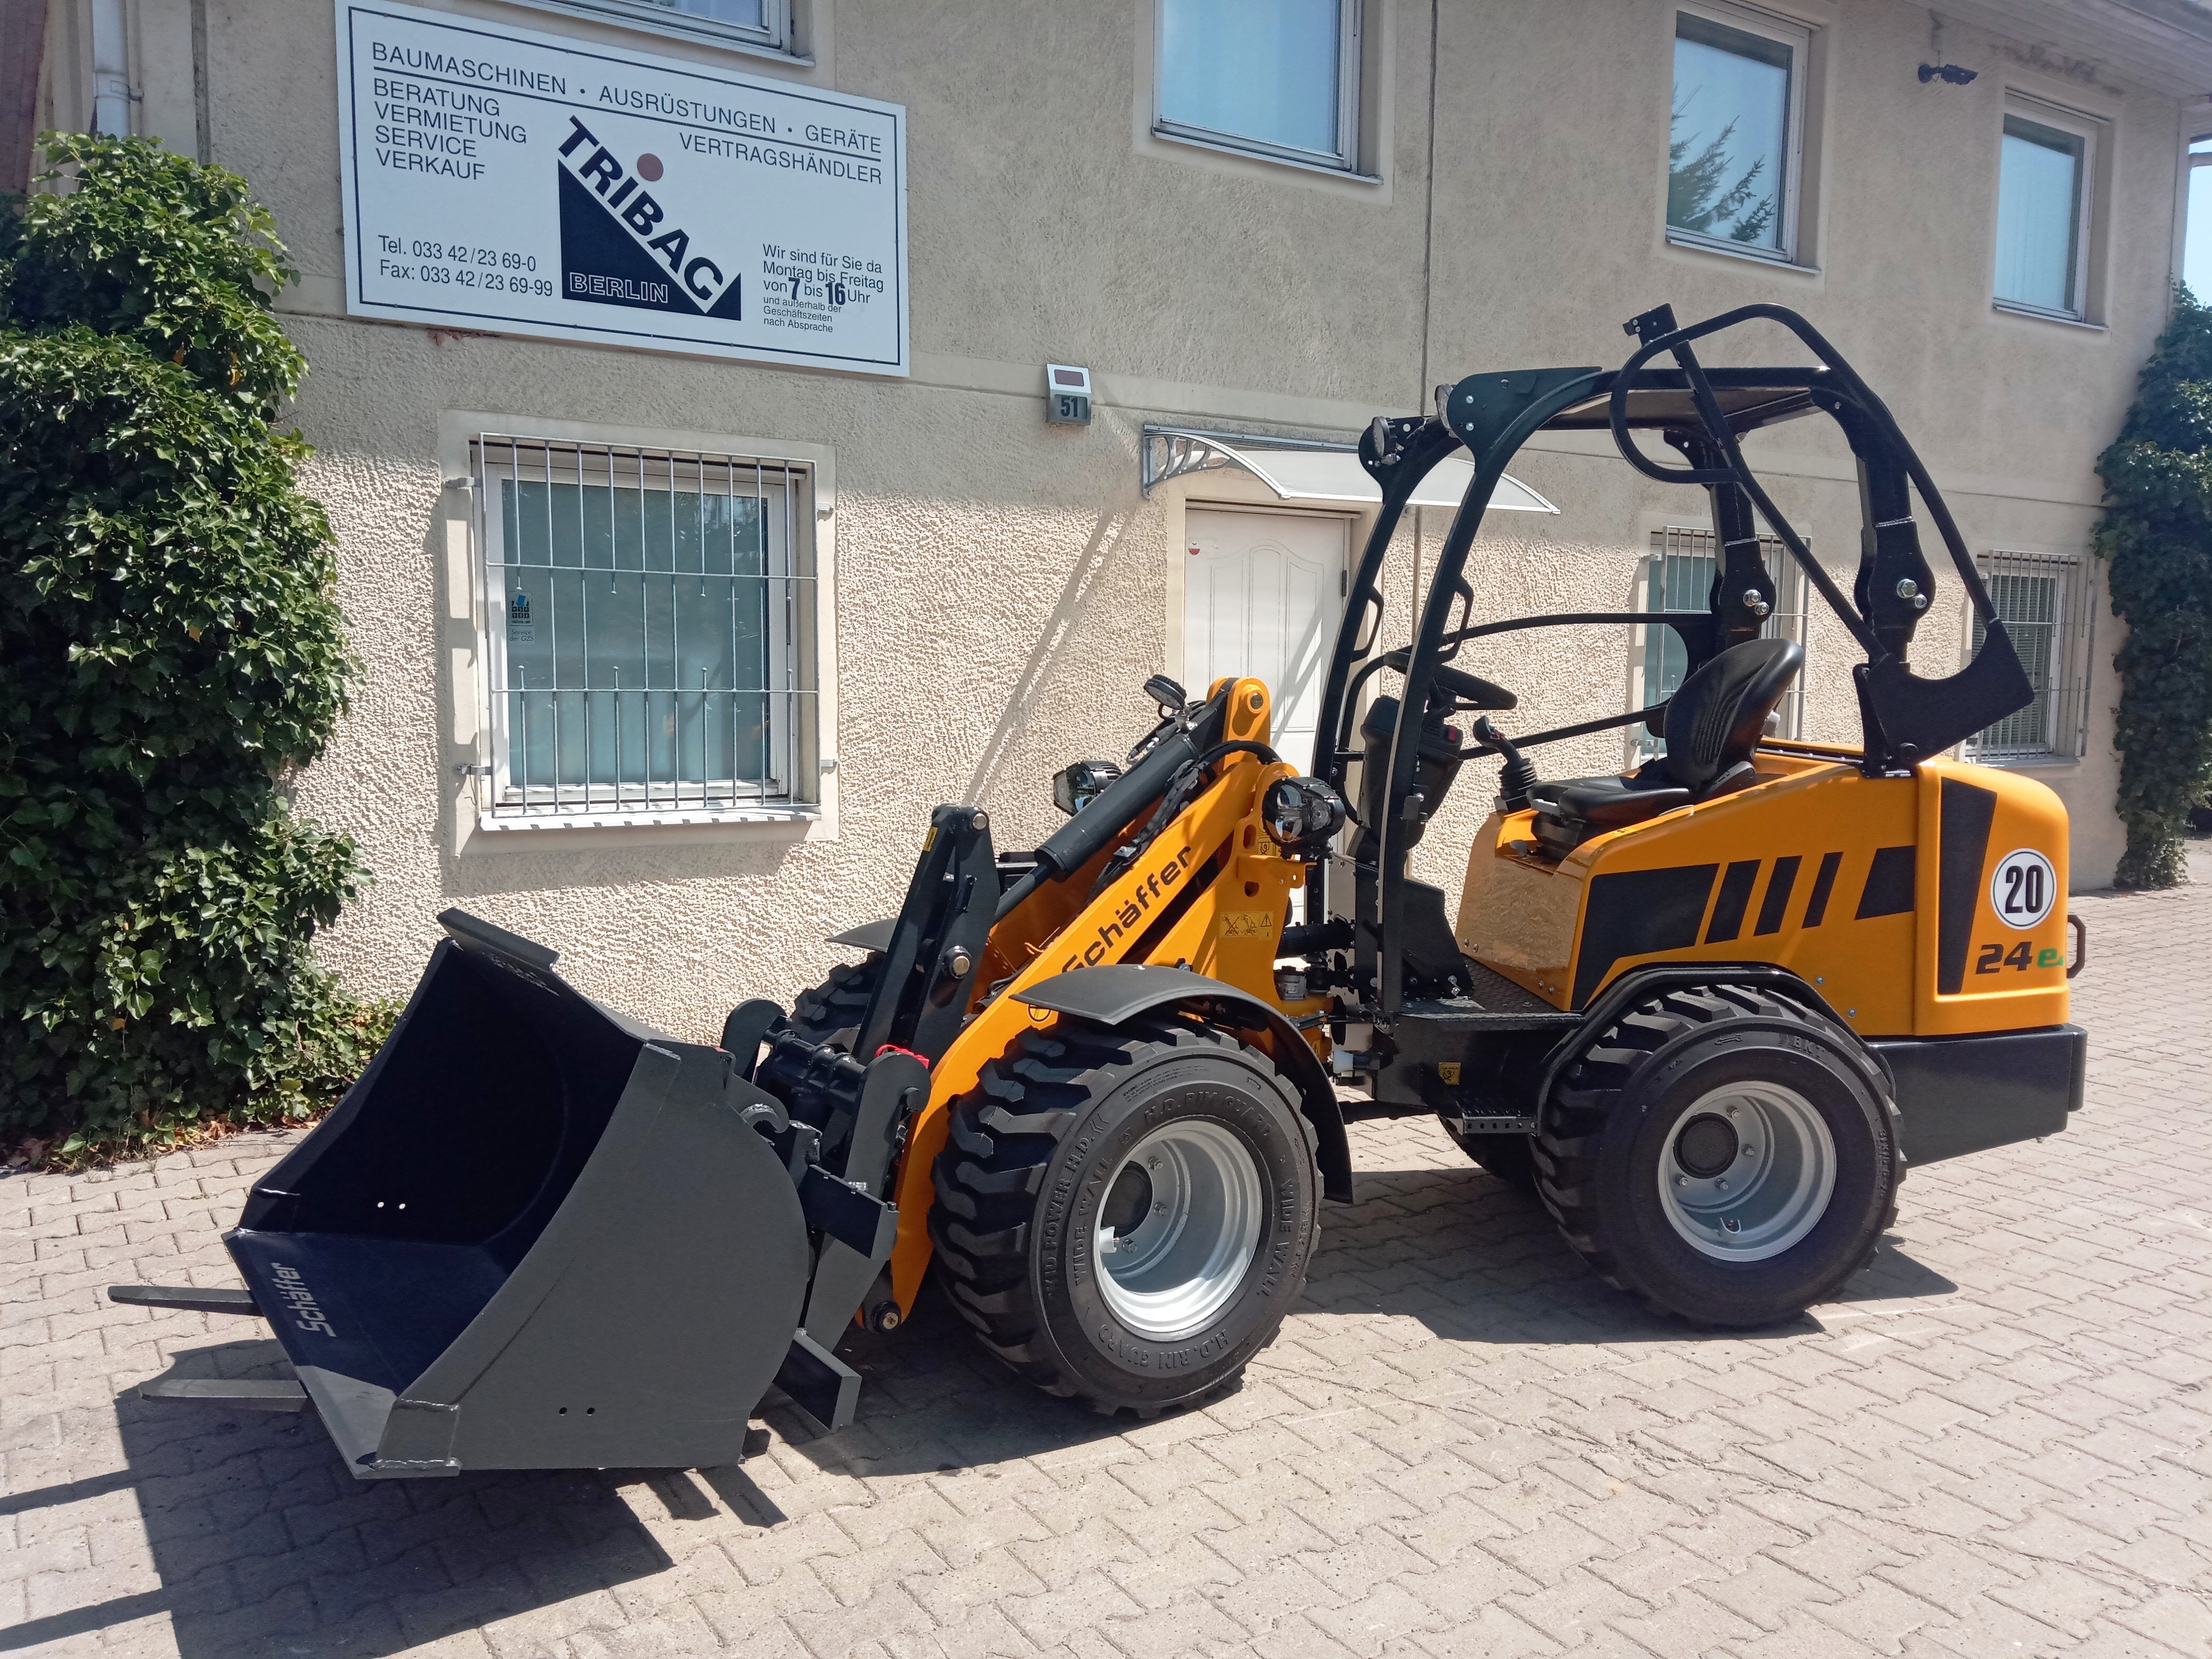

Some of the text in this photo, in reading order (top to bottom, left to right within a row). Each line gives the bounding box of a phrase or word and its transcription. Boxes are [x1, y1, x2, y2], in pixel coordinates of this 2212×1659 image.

[372, 41, 882, 154] BAUMASCHINEN AUSRÜSTUNGEN GERÄTE
[373, 77, 500, 118] BERATUNG
[373, 100, 527, 145] VERMIETUNG
[374, 124, 477, 158] SERVICE
[678, 131, 882, 185] VERTRAGSHÄNDLER
[375, 147, 486, 181] VERKAUF
[377, 234, 407, 256] Tel.
[412, 239, 443, 260] 033
[501, 252, 537, 273] 69-0
[761, 242, 883, 274] Wir sind für Sie da
[380, 258, 415, 281] Fax:
[420, 264, 451, 284] 033
[509, 275, 553, 297] 69-99
[569, 272, 669, 303] BERLIN
[763, 277, 870, 305] von 7 bis 16 Uhr
[764, 260, 883, 292] Montag bis Freitag
[763, 305, 833, 322] Geschäftszeiten
[764, 296, 842, 313] und außerhalb der
[764, 317, 833, 332] nach Absprache
[1060, 395, 1078, 417] 51
[2005, 865, 2045, 914] 20
[1044, 1176, 1070, 1251] POWER
[1071, 1224, 1087, 1288] WIDE
[271, 1262, 337, 1337] Schäffer
